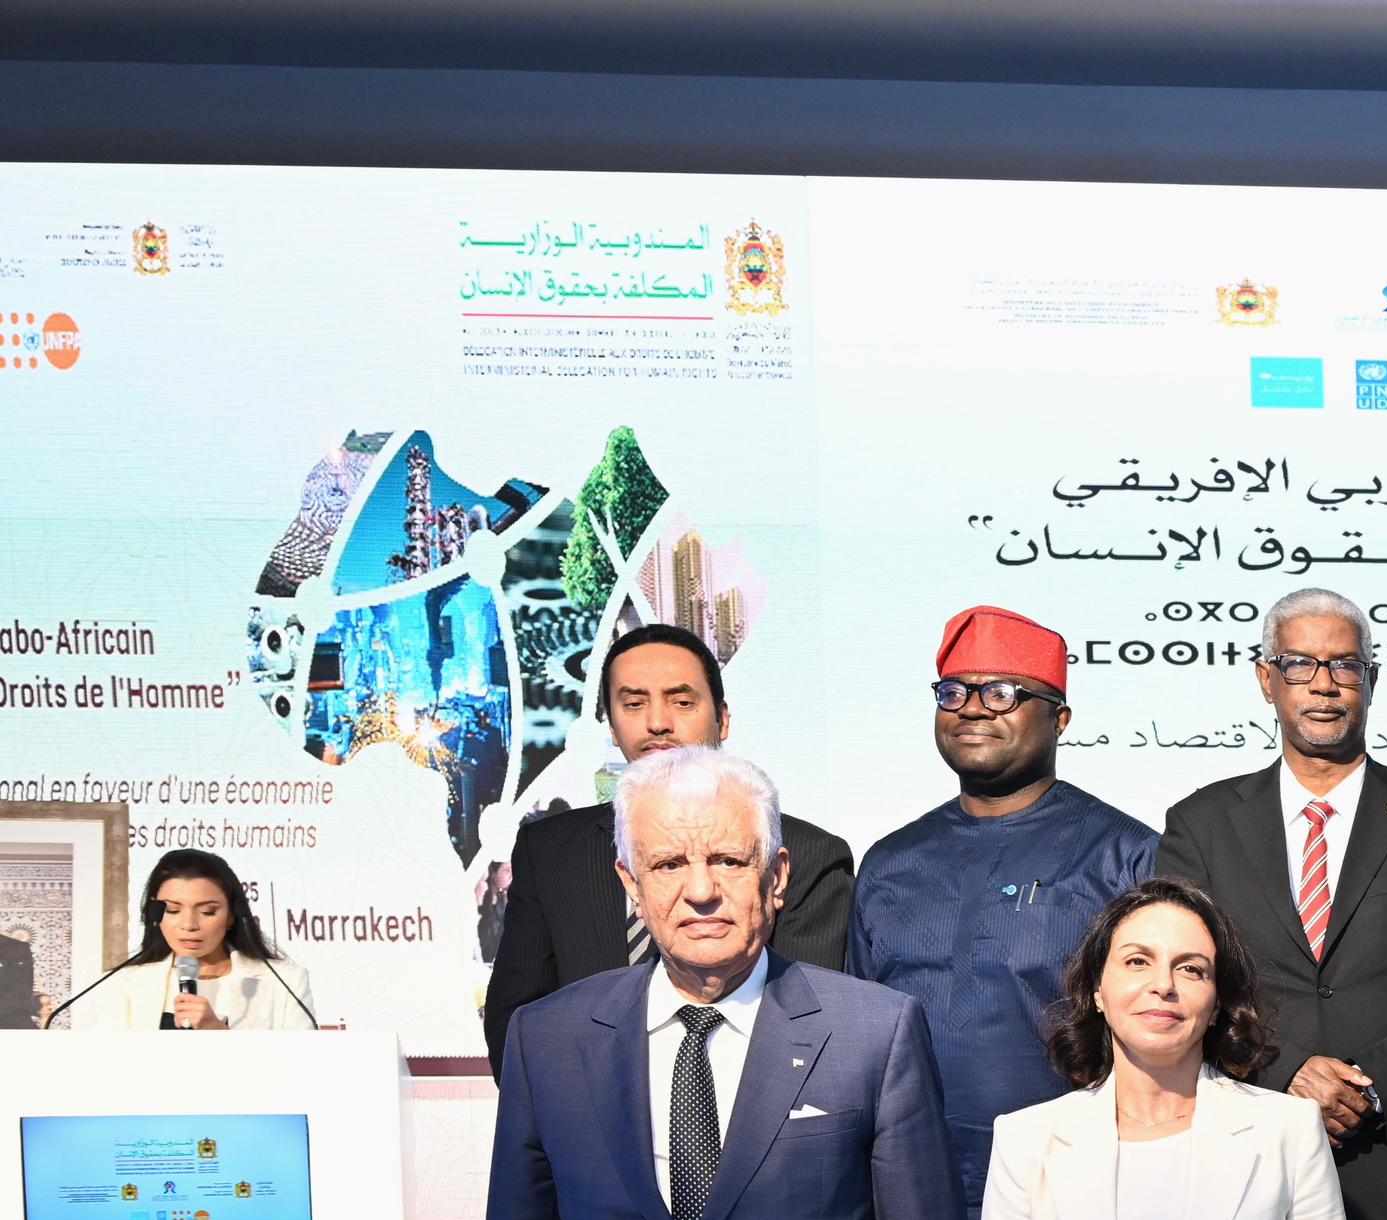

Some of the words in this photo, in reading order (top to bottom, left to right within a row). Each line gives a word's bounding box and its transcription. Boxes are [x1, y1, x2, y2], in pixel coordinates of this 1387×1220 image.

[460, 220, 583, 257] الوزارية
[589, 222, 710, 257] المندوبية
[538, 269, 609, 305] بحقوق
[612, 271, 714, 300] المكلفة
[1052, 457, 1289, 508] الإفريقي
[1145, 601, 1259, 622] ⴰⵙⴳⵔ
[74, 675, 104, 708] de
[50, 779, 77, 801] en
[83, 772, 153, 804] faveur
[158, 775, 220, 804] d'une
[225, 775, 334, 804] économie
[128, 824, 149, 848] es
[154, 817, 217, 848] droits
[222, 818, 318, 849] humains
[240, 881, 260, 902] 25
[287, 906, 434, 943] Marrakech
